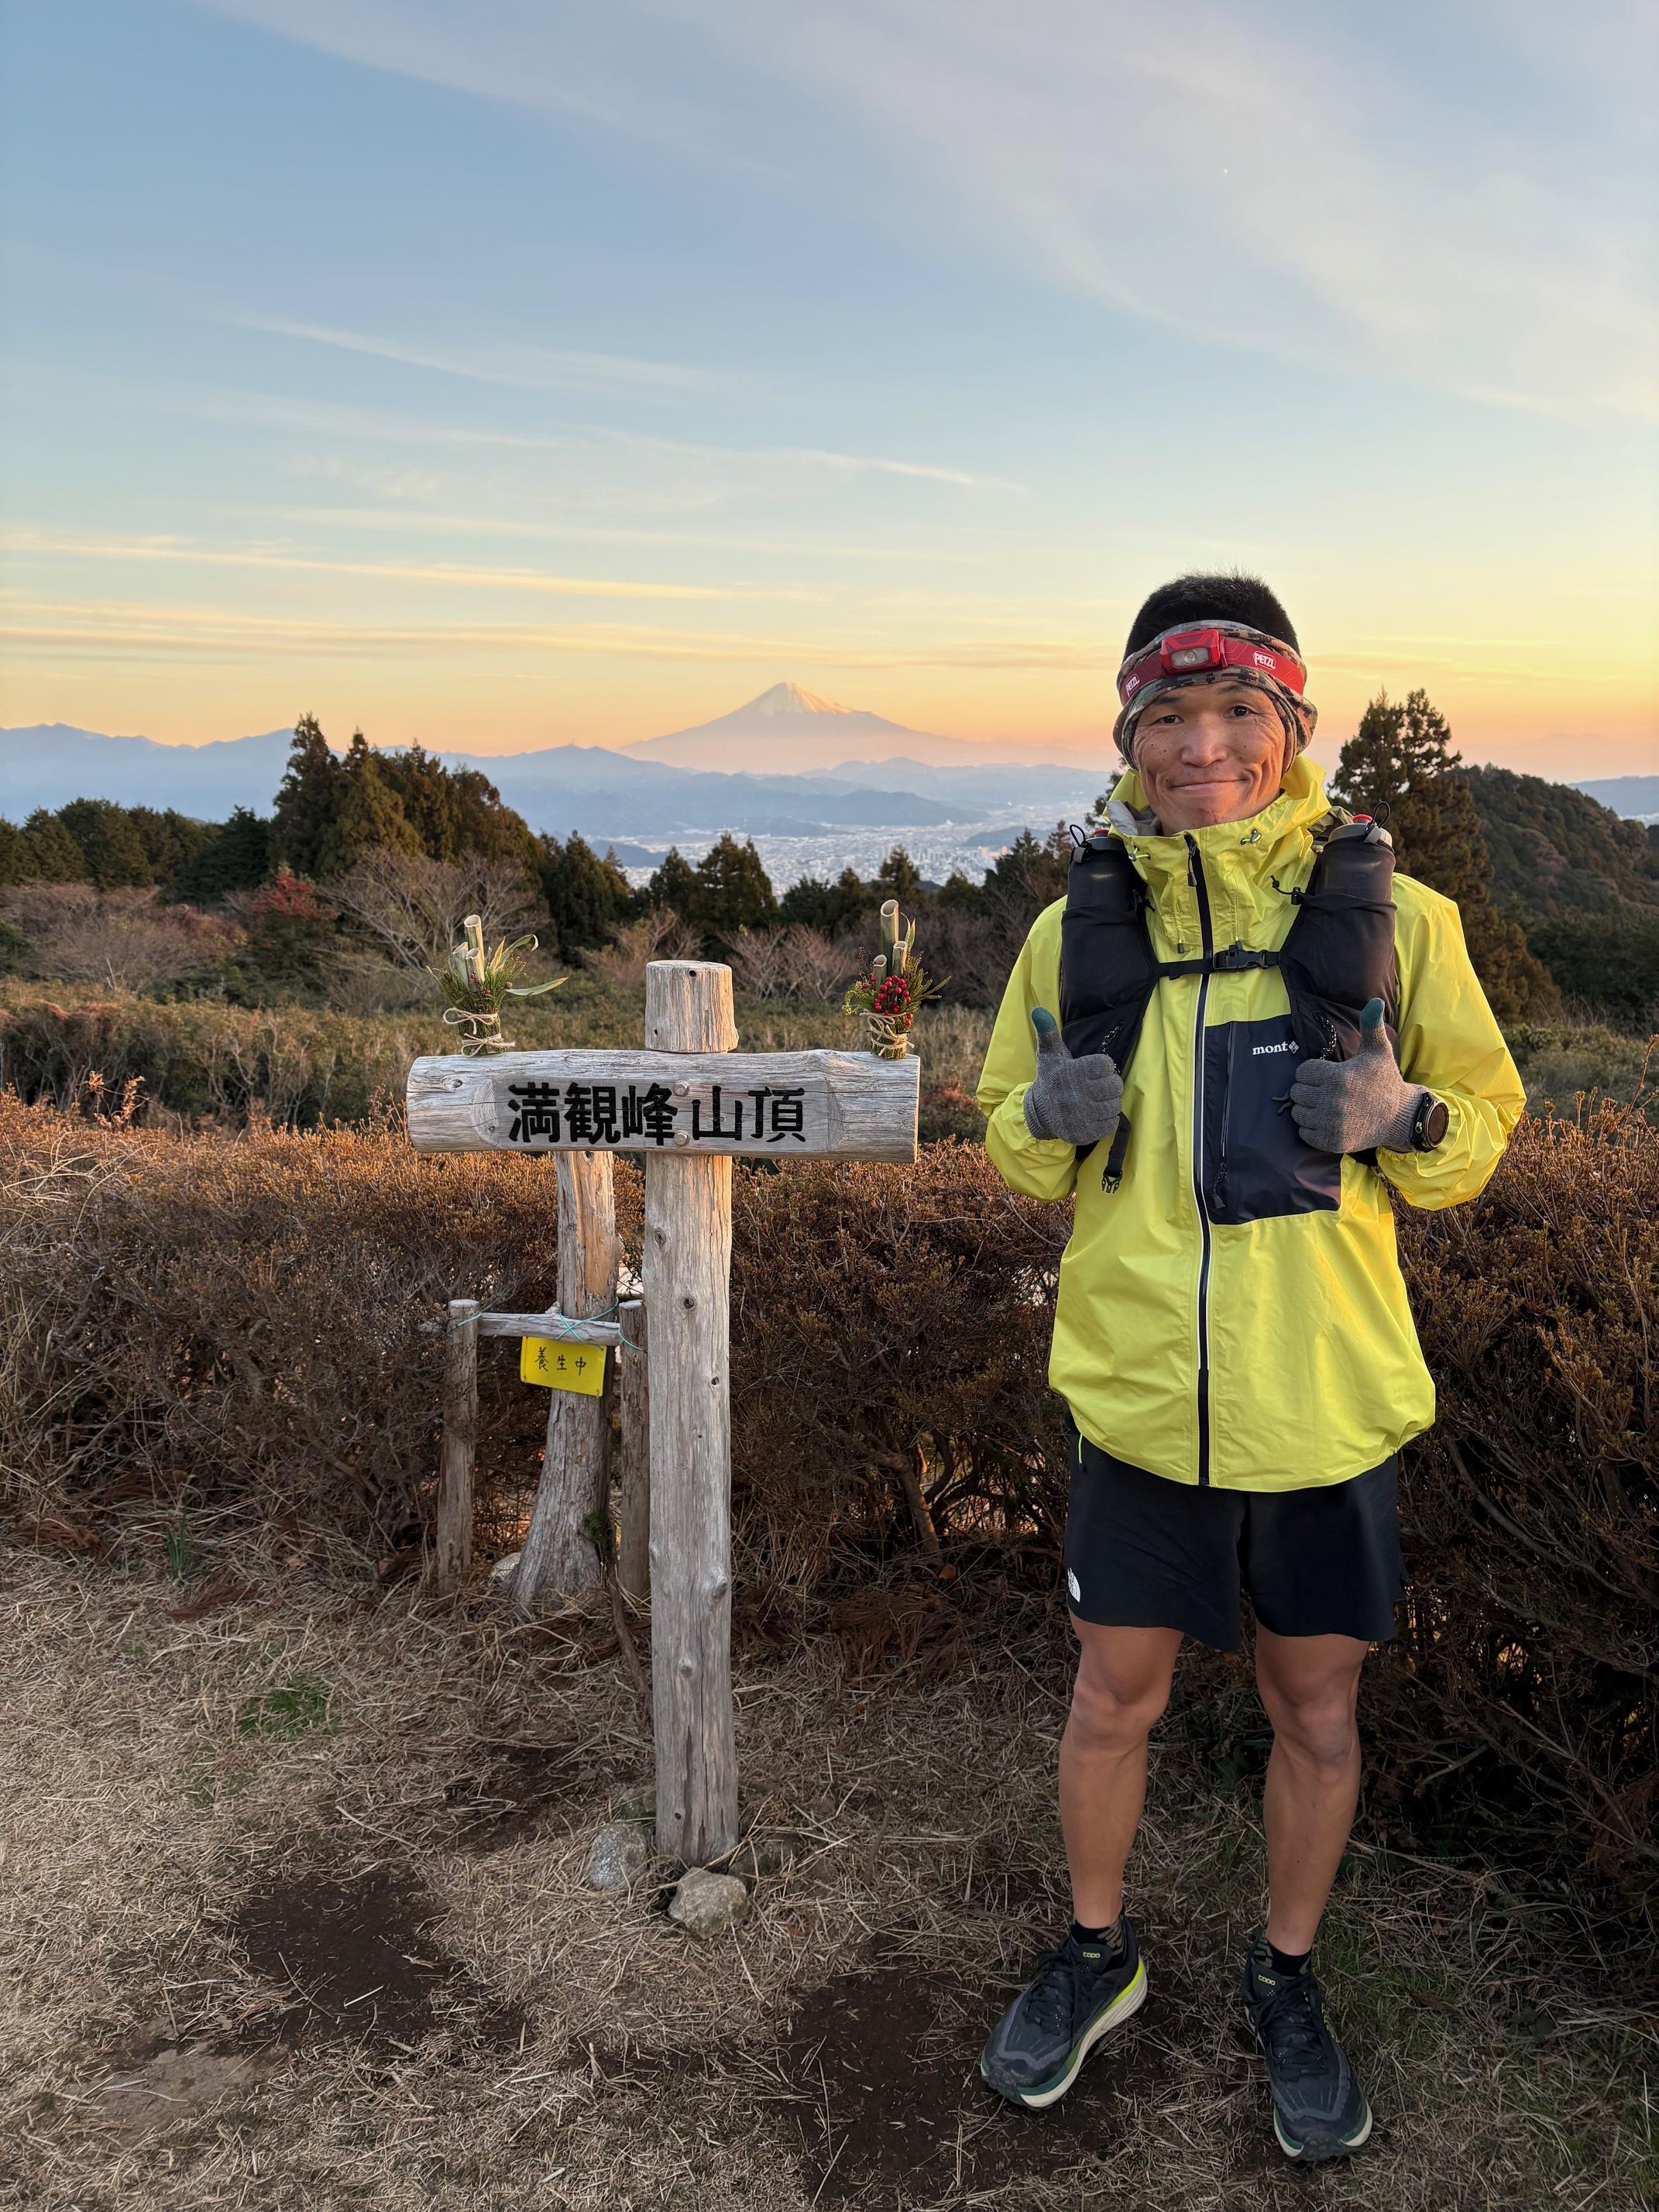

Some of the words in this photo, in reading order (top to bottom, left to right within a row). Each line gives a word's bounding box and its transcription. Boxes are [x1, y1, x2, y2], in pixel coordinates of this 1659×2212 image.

[1254, 652, 1276, 669] PETZL
[1126, 675, 1140, 698] PETZL
[1252, 1041, 1288, 1055] mont
[508, 1081, 805, 1146] 満観峰山頂
[534, 1347, 586, 1376] 養生中
[1258, 1974, 1276, 1985] topo
